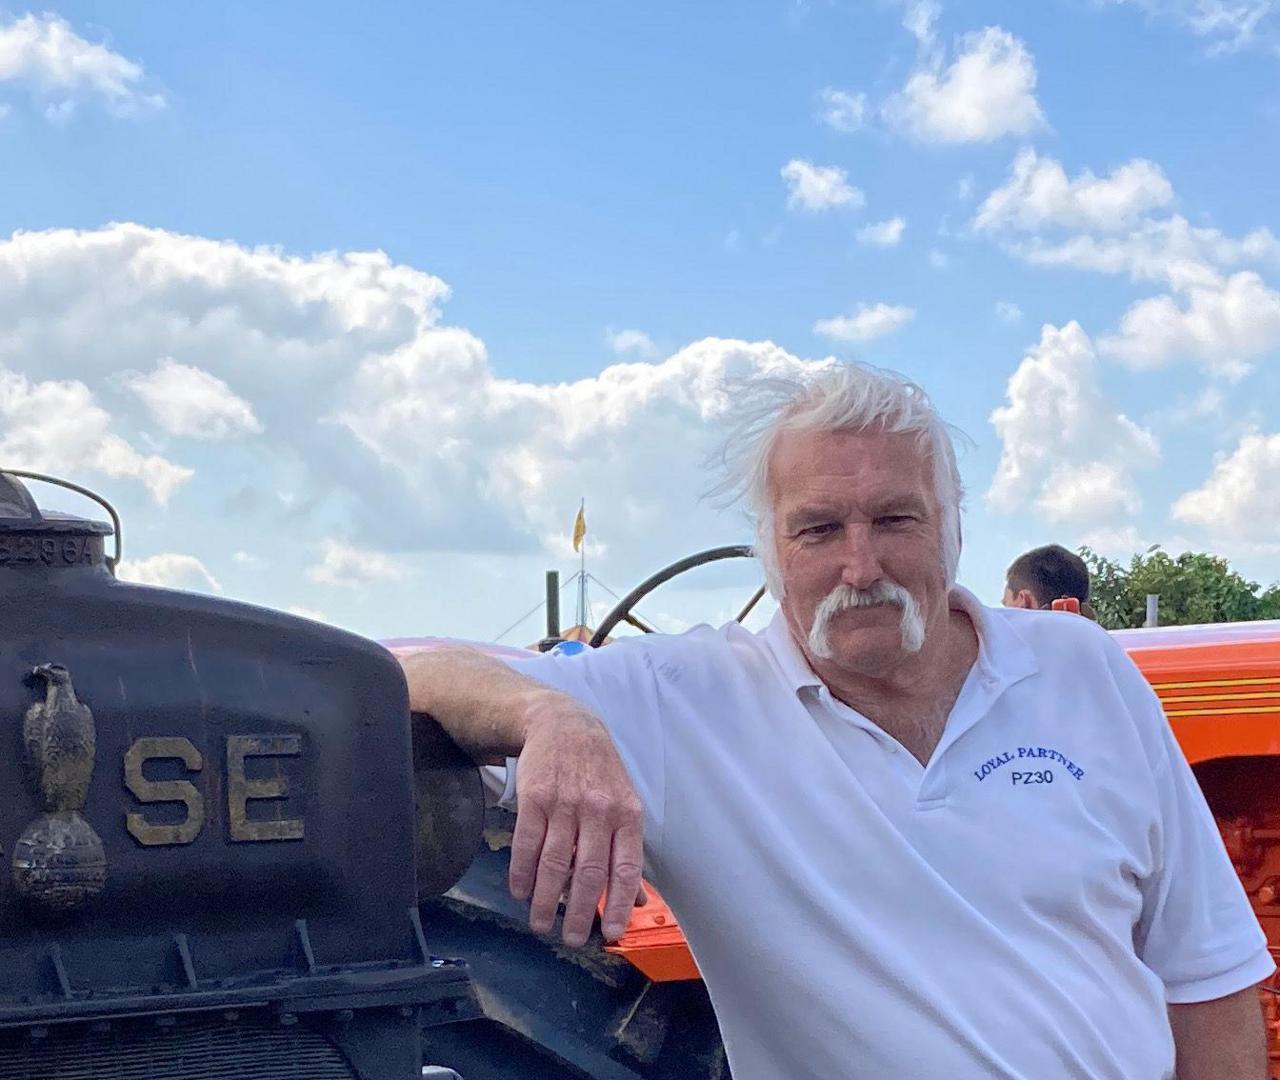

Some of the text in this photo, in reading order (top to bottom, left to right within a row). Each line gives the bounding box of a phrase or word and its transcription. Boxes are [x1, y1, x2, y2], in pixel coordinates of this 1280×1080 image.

[974, 747, 1086, 782] LOYAL PARTNER
[1011, 770, 1054, 785] PZ30
